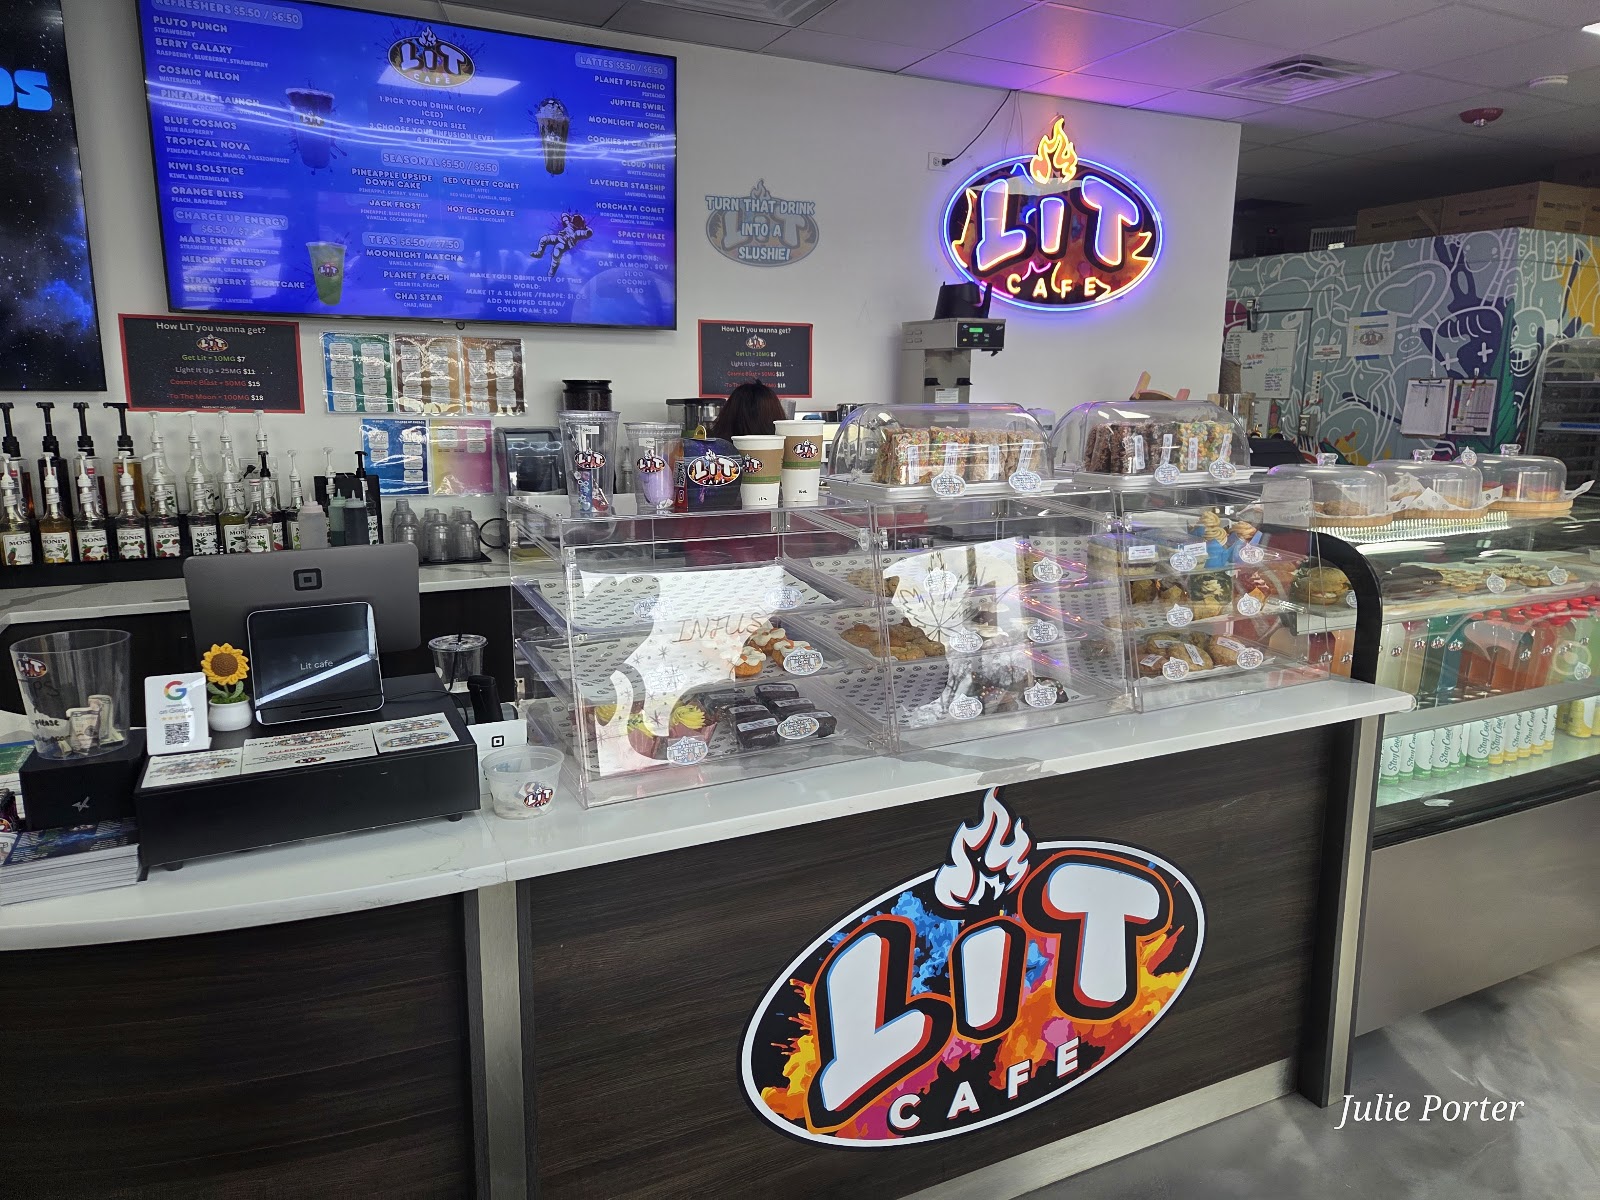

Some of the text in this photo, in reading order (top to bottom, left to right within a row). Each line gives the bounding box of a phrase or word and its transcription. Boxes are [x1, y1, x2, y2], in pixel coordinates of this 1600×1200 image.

[234, 6, 261, 18] $5.50
[272, 12, 299, 24] $6.50
[153, 16, 228, 33] PLUTO PUNCH
[156, 38, 232, 54] BERRY GALAXY
[580, 56, 613, 68] LATTES
[616, 61, 635, 71] $5.50
[159, 65, 240, 81] COSMIC MELON
[413, 73, 450, 84] CAFE
[595, 76, 665, 91] PLANET PISTACHIO
[161, 90, 260, 107] PINEAPPLE LAUNCH
[407, 99, 475, 114] YOUR DRINK (HOT
[610, 99, 665, 111] JUPITER SWIRL
[421, 110, 444, 119] ICED)
[164, 116, 237, 129] BLUE COSMOS
[589, 116, 665, 131] MOONLIGHT MOCHA
[412, 127, 495, 142] YOUR INFUSION LEVEL
[166, 136, 251, 151] TROPICAL NOVA
[588, 135, 663, 150] COOKIES CRATERS
[169, 162, 244, 175] KIWI SOLSTICE
[383, 154, 498, 173] SEASONAL $5.50 $6.50
[621, 160, 665, 170] CLOUD NINE
[351, 168, 432, 182] PINEAPPLE UPSIDE
[365, 178, 421, 190] DOWN CAKE
[461, 178, 489, 187] VELVET
[492, 181, 520, 190] COMET
[590, 179, 665, 191] LAVENDER STARSHIP
[171, 187, 244, 199] ORANGE BLISS
[369, 200, 421, 210] JACK FROST
[447, 205, 515, 217] HOT CHOCOLATE
[596, 202, 665, 214] HORCHATA COMET
[705, 195, 815, 215] TURN THAT DRINK
[176, 211, 285, 227] CHARGE UP ENERGY
[201, 225, 227, 234] $6.50
[617, 230, 644, 238] SPACEY
[741, 223, 782, 236] INTO A
[210, 237, 246, 246] ENERGY
[369, 235, 425, 247] TEAS $6.50
[182, 256, 267, 267] MERCURY ENERGY
[367, 250, 464, 262] MOONLIGHT MATCHA
[383, 271, 450, 281] PLANET PEACH
[470, 272, 491, 280] MAKE
[493, 273, 512, 281] YOUR
[513, 274, 535, 282] DRINK
[184, 277, 305, 289] STRAWBERRY SHORTCAKE
[1006, 273, 1097, 298] CAFE
[395, 292, 443, 301] CHAI STAR
[505, 290, 532, 298] SLUSHIE
[156, 322, 178, 330] How
[180, 323, 193, 331] LIT
[196, 325, 214, 333] you
[247, 327, 266, 335] get?
[175, 366, 194, 374] Light
[300, 659, 333, 670] Lit cafe
[169, 706, 195, 714] Google
[887, 1037, 1081, 1130] CAFE
